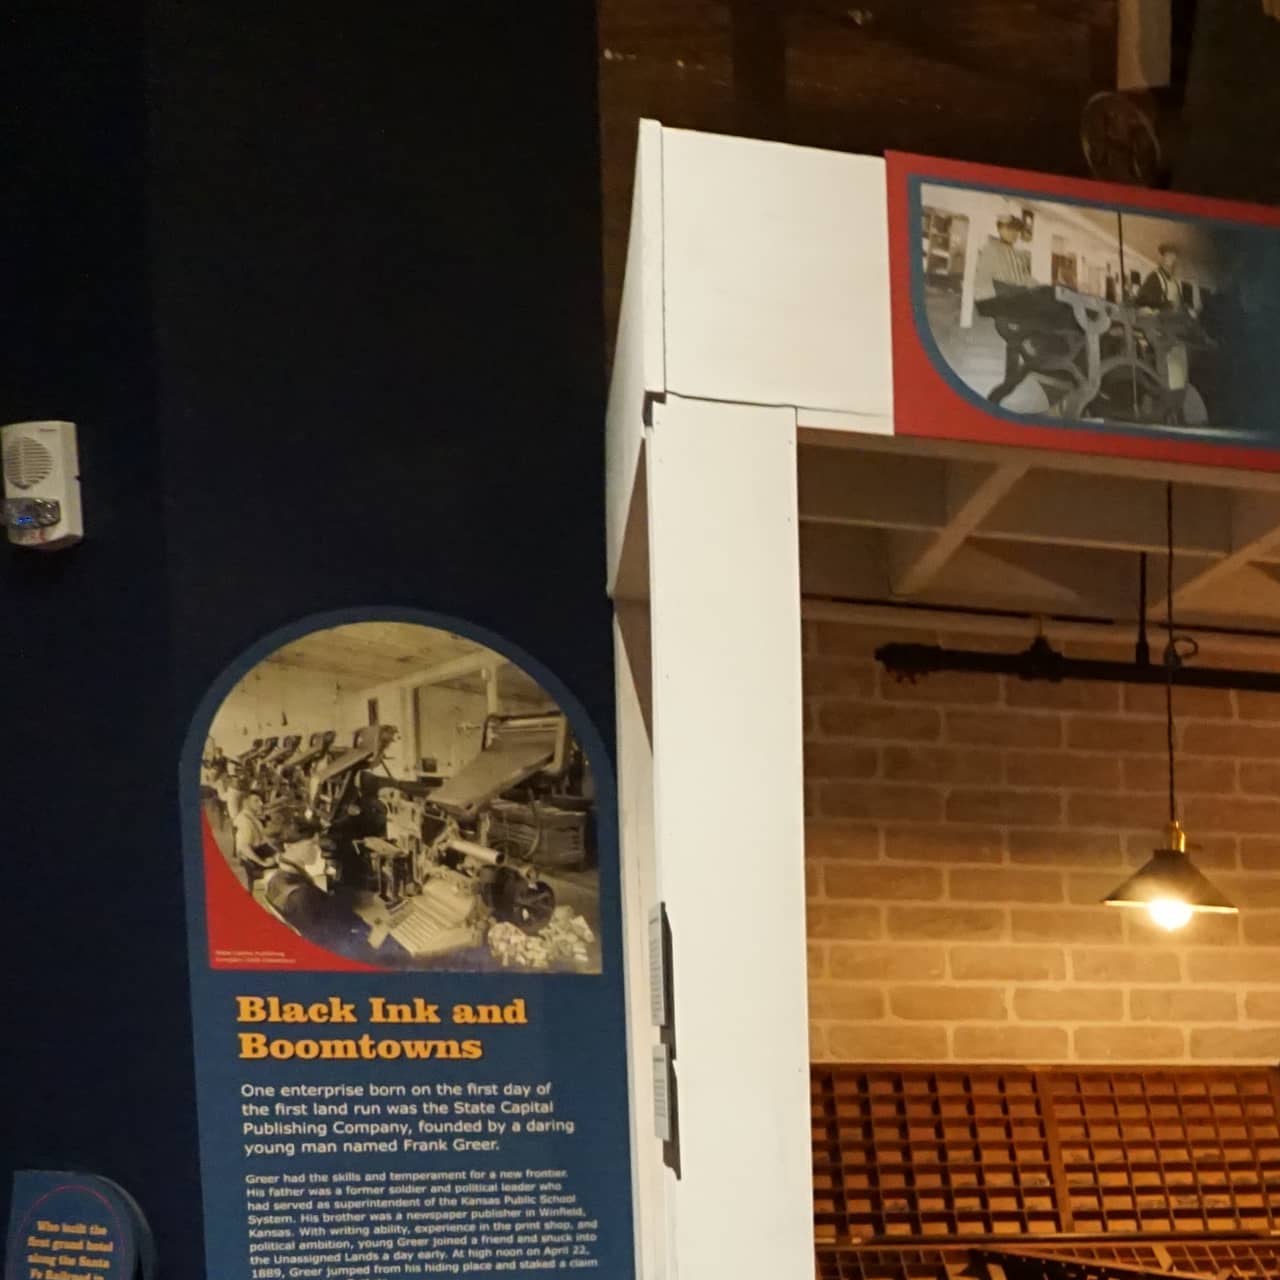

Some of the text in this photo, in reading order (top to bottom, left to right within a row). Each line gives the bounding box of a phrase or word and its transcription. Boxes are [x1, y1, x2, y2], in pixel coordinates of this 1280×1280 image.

[236, 996, 526, 1023] Black Ink and
[238, 1033, 482, 1058] Boomtowns
[240, 1082, 551, 1097] One enterprise born on the first day of
[241, 1101, 553, 1115] the first land run was the State Capital
[243, 1119, 574, 1136] Publishing Company, founded by a daring
[244, 1138, 499, 1156] young man named Frank Greer.
[245, 1174, 280, 1183] Greer
[282, 1173, 305, 1183] had
[308, 1173, 328, 1182] the
[331, 1172, 361, 1182] skills
[364, 1172, 386, 1181] and
[389, 1171, 466, 1181] temperament
[469, 1169, 485, 1179] for
[488, 1171, 496, 1179] a
[499, 1170, 522, 1178] new
